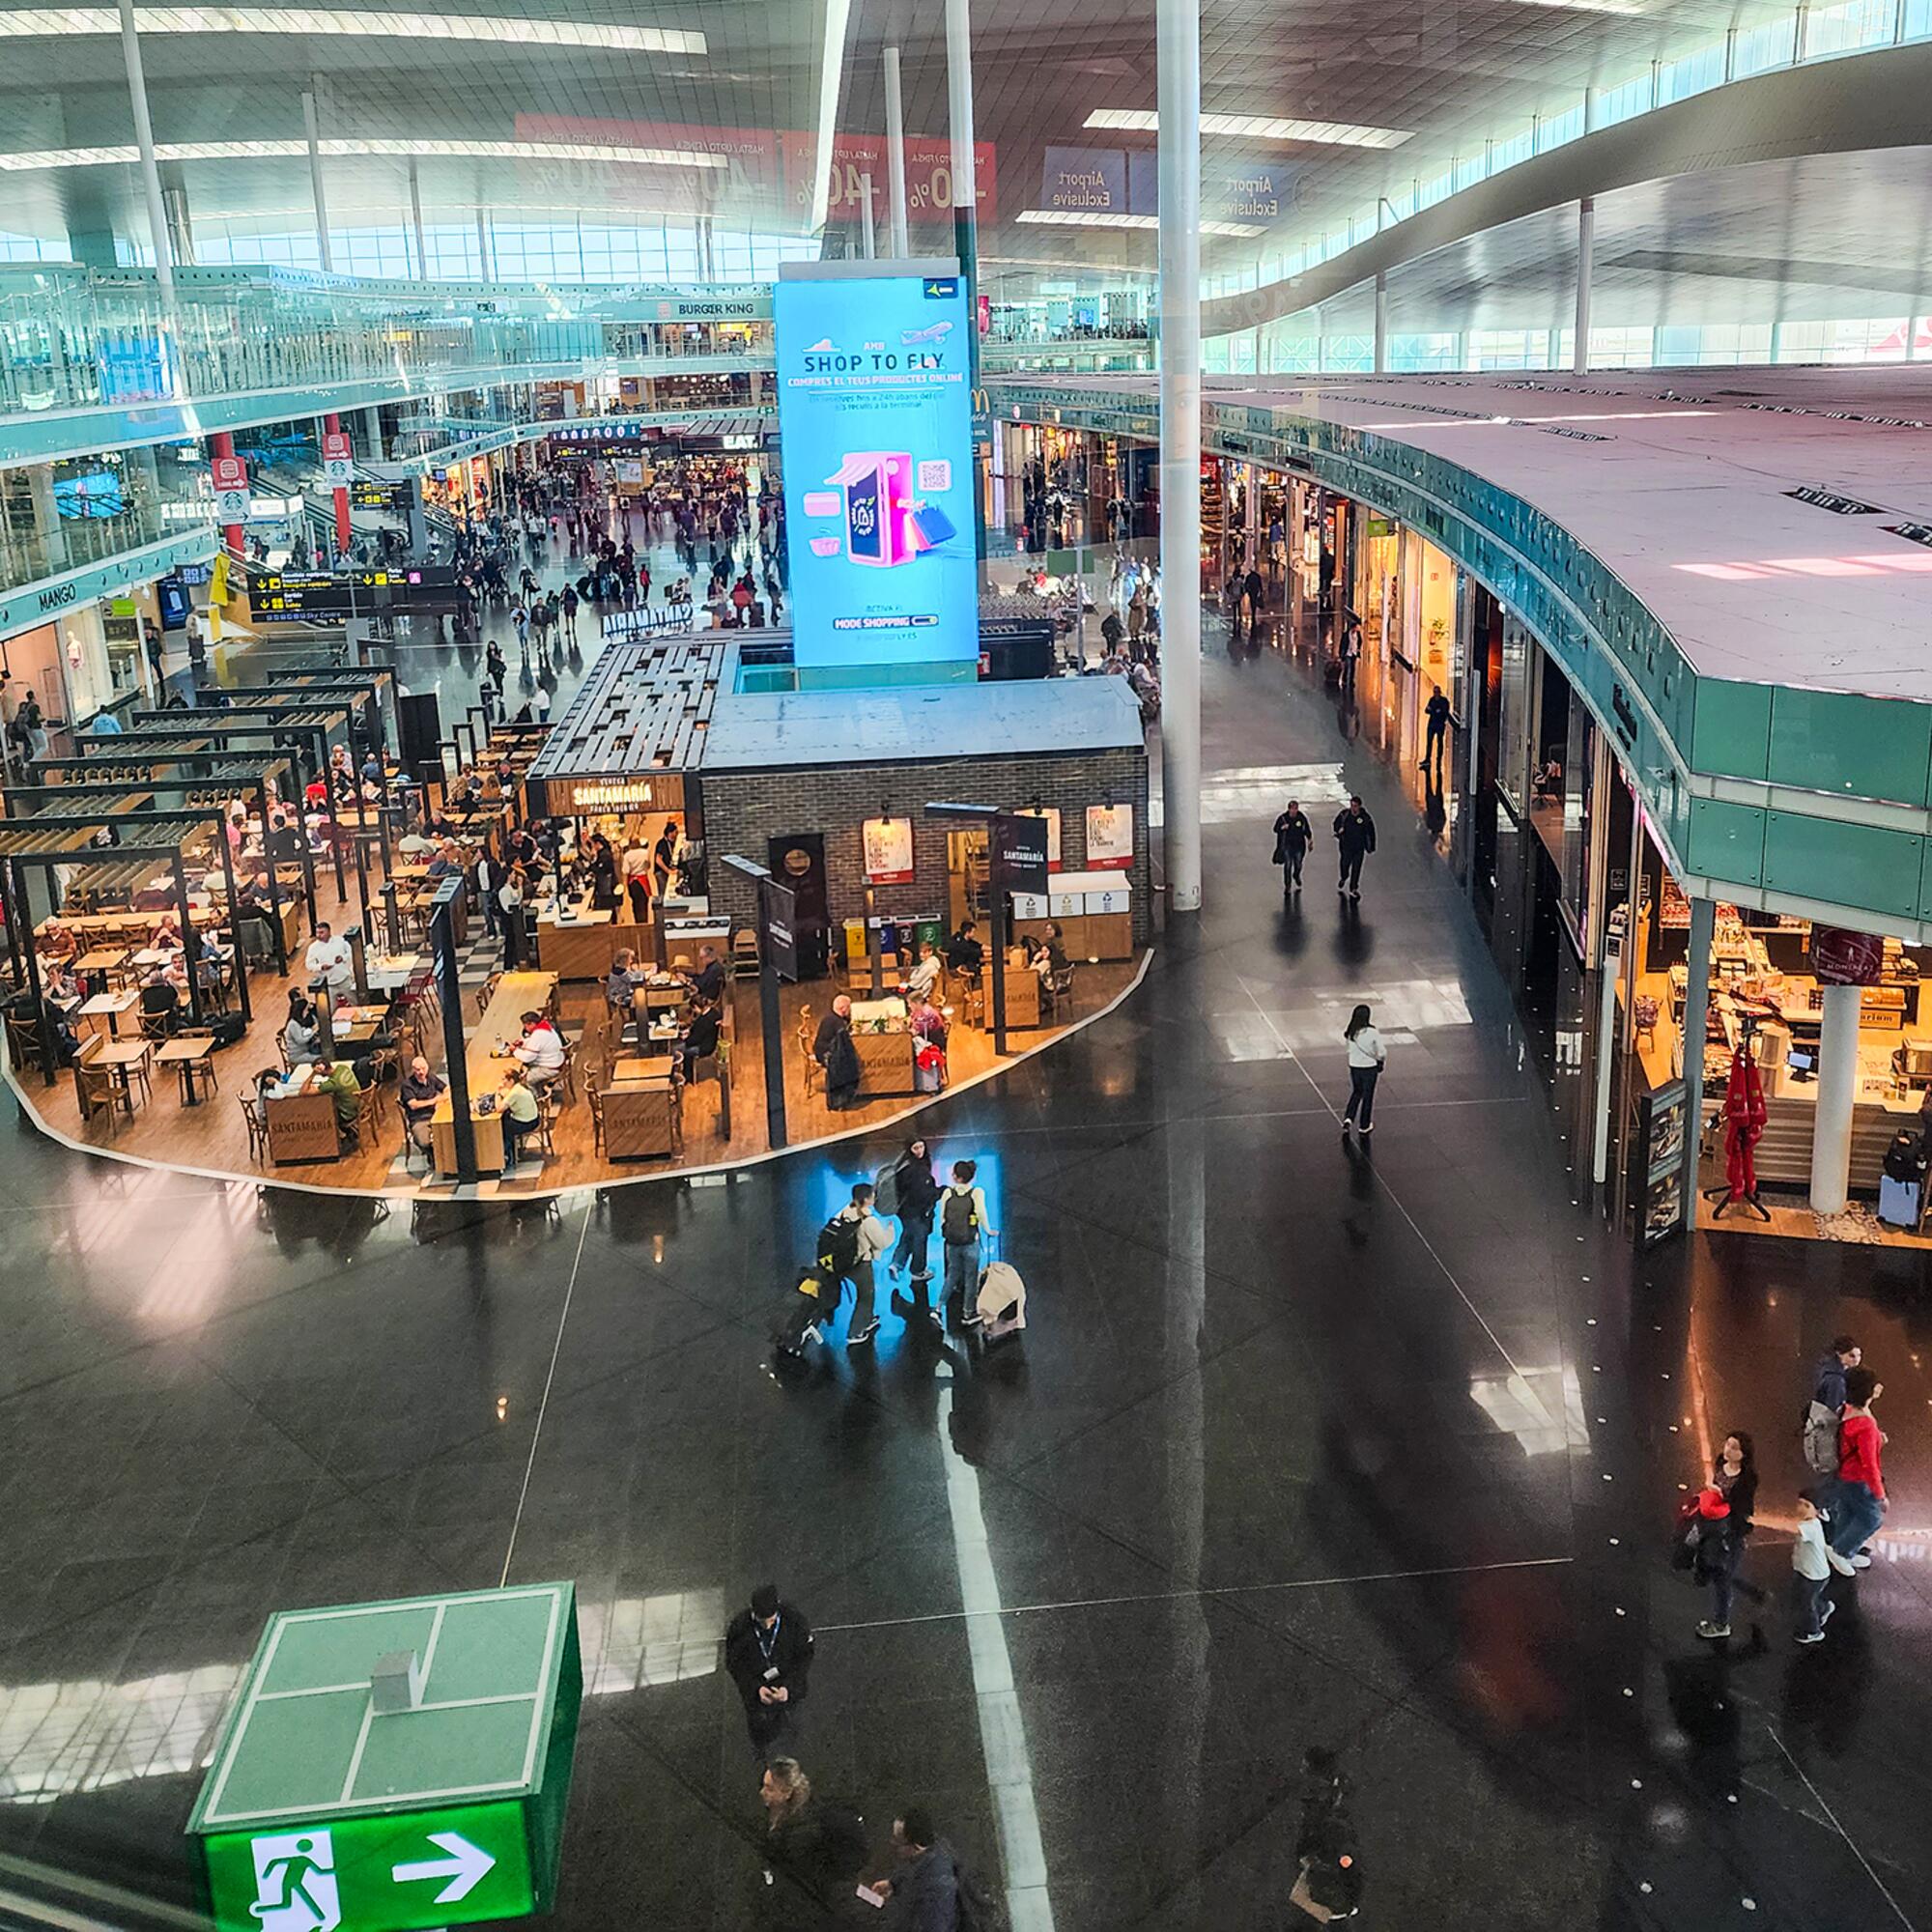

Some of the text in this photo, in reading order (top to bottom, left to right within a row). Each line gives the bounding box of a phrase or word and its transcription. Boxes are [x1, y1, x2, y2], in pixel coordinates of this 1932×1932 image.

[679, 303, 753, 314] BURGER KING
[805, 353, 944, 372] SHOP TO FLY
[39, 583, 76, 611] MANGO
[835, 616, 910, 629] MODE SHOPPING
[573, 781, 652, 806] SANTAMARÍA
